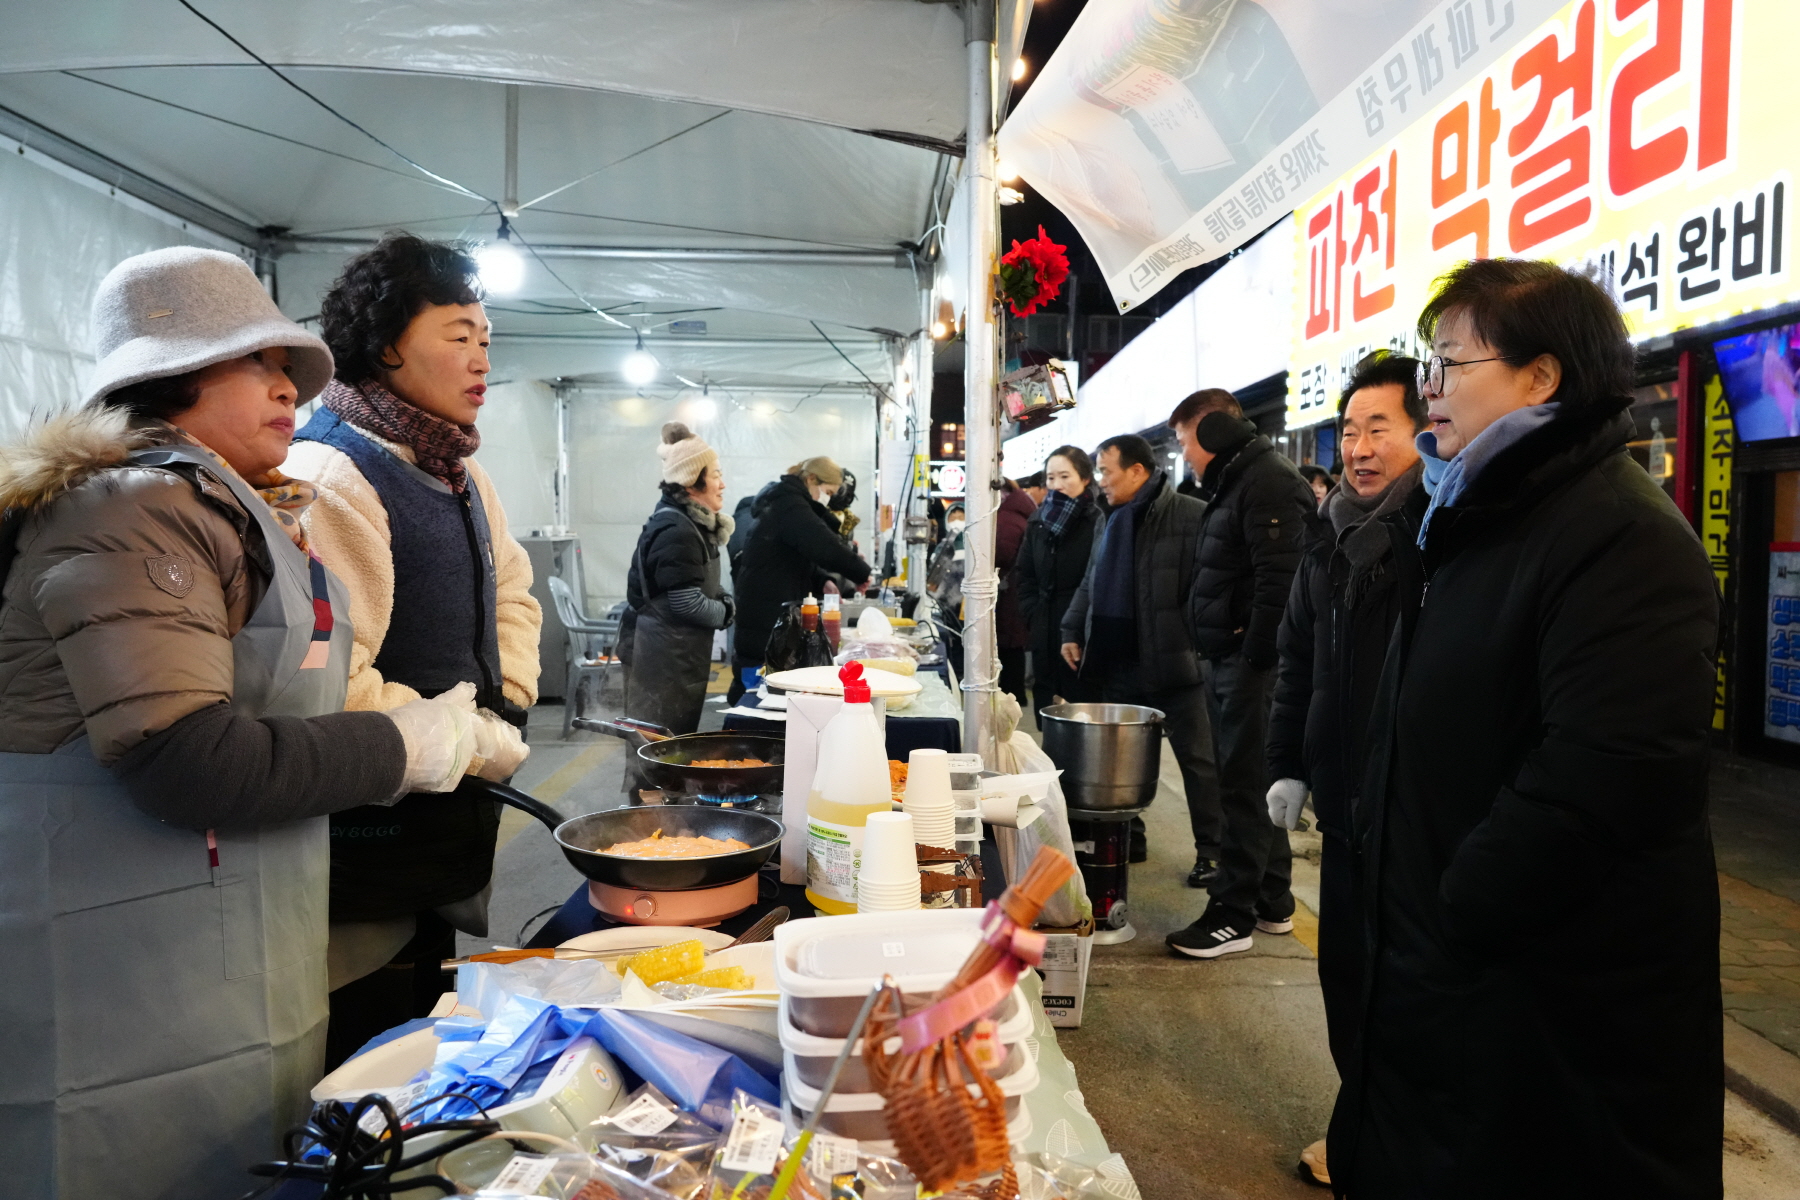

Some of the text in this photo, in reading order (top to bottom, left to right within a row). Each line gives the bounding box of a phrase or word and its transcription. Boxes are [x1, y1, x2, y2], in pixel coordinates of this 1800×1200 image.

[1300, 362, 1327, 410] 포장
[1678, 181, 1784, 301] 완비
[1305, 0, 1734, 342] 파전 막걸리
